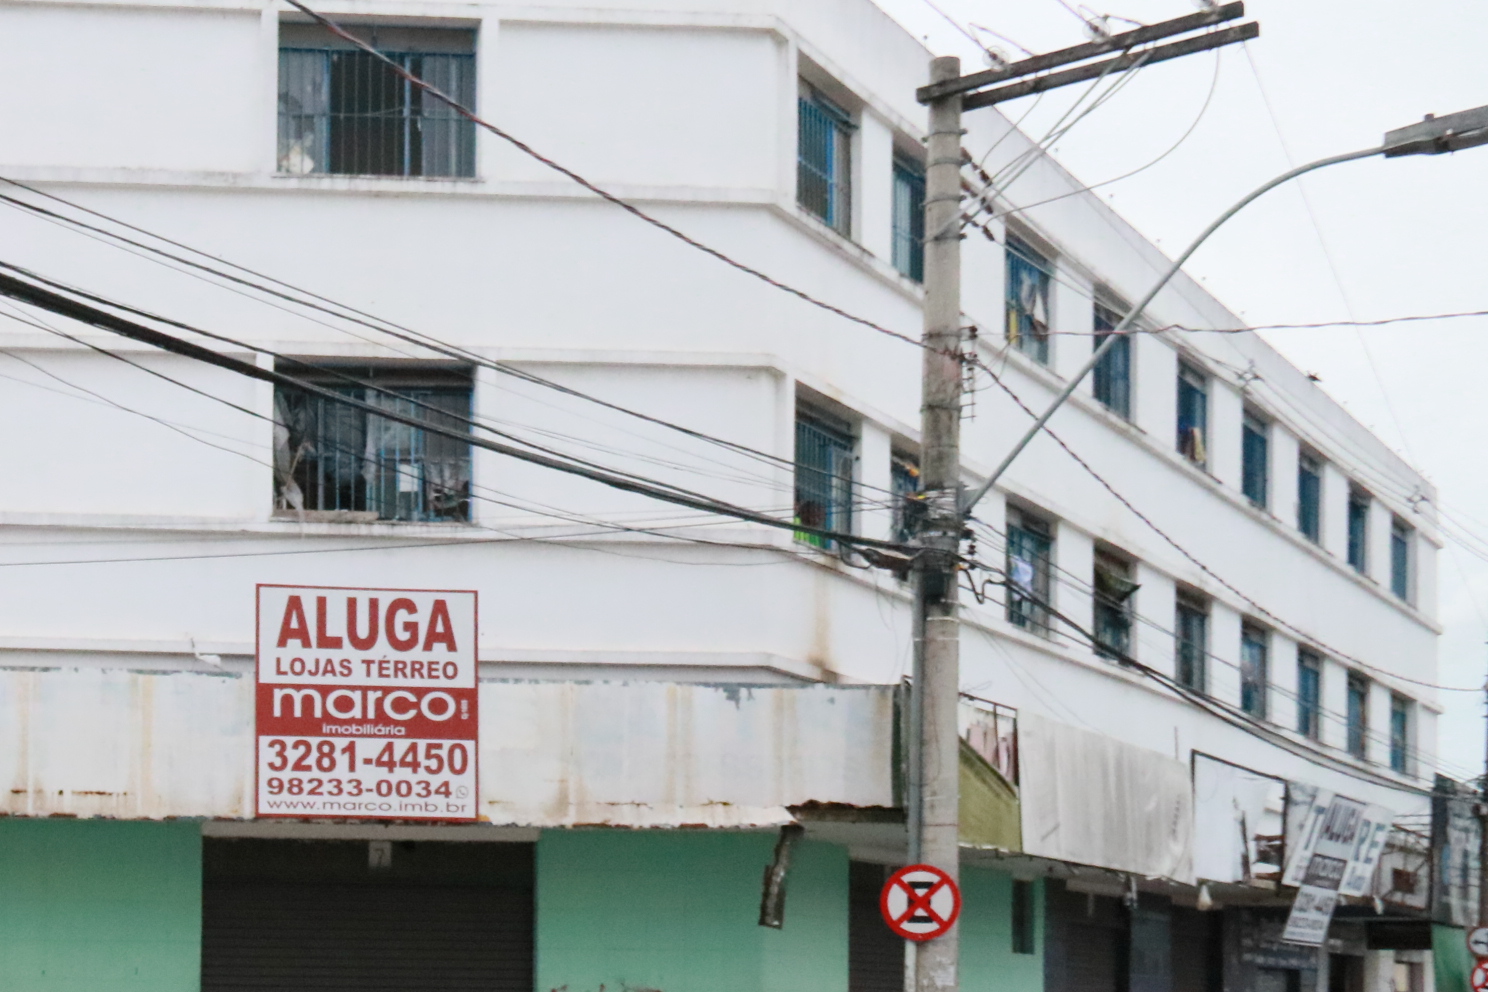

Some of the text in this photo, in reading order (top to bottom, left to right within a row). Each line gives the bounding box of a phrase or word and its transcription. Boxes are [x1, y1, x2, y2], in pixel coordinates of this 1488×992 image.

[276, 595, 458, 652] ALUGA
[275, 655, 458, 680] LOJAS TÉRREO
[272, 687, 457, 722] marco
[322, 723, 406, 736] imobiliária
[267, 739, 469, 775] 3281-4450
[266, 777, 452, 798] 98233-0034
[267, 800, 468, 814] www.marco.imb.br
